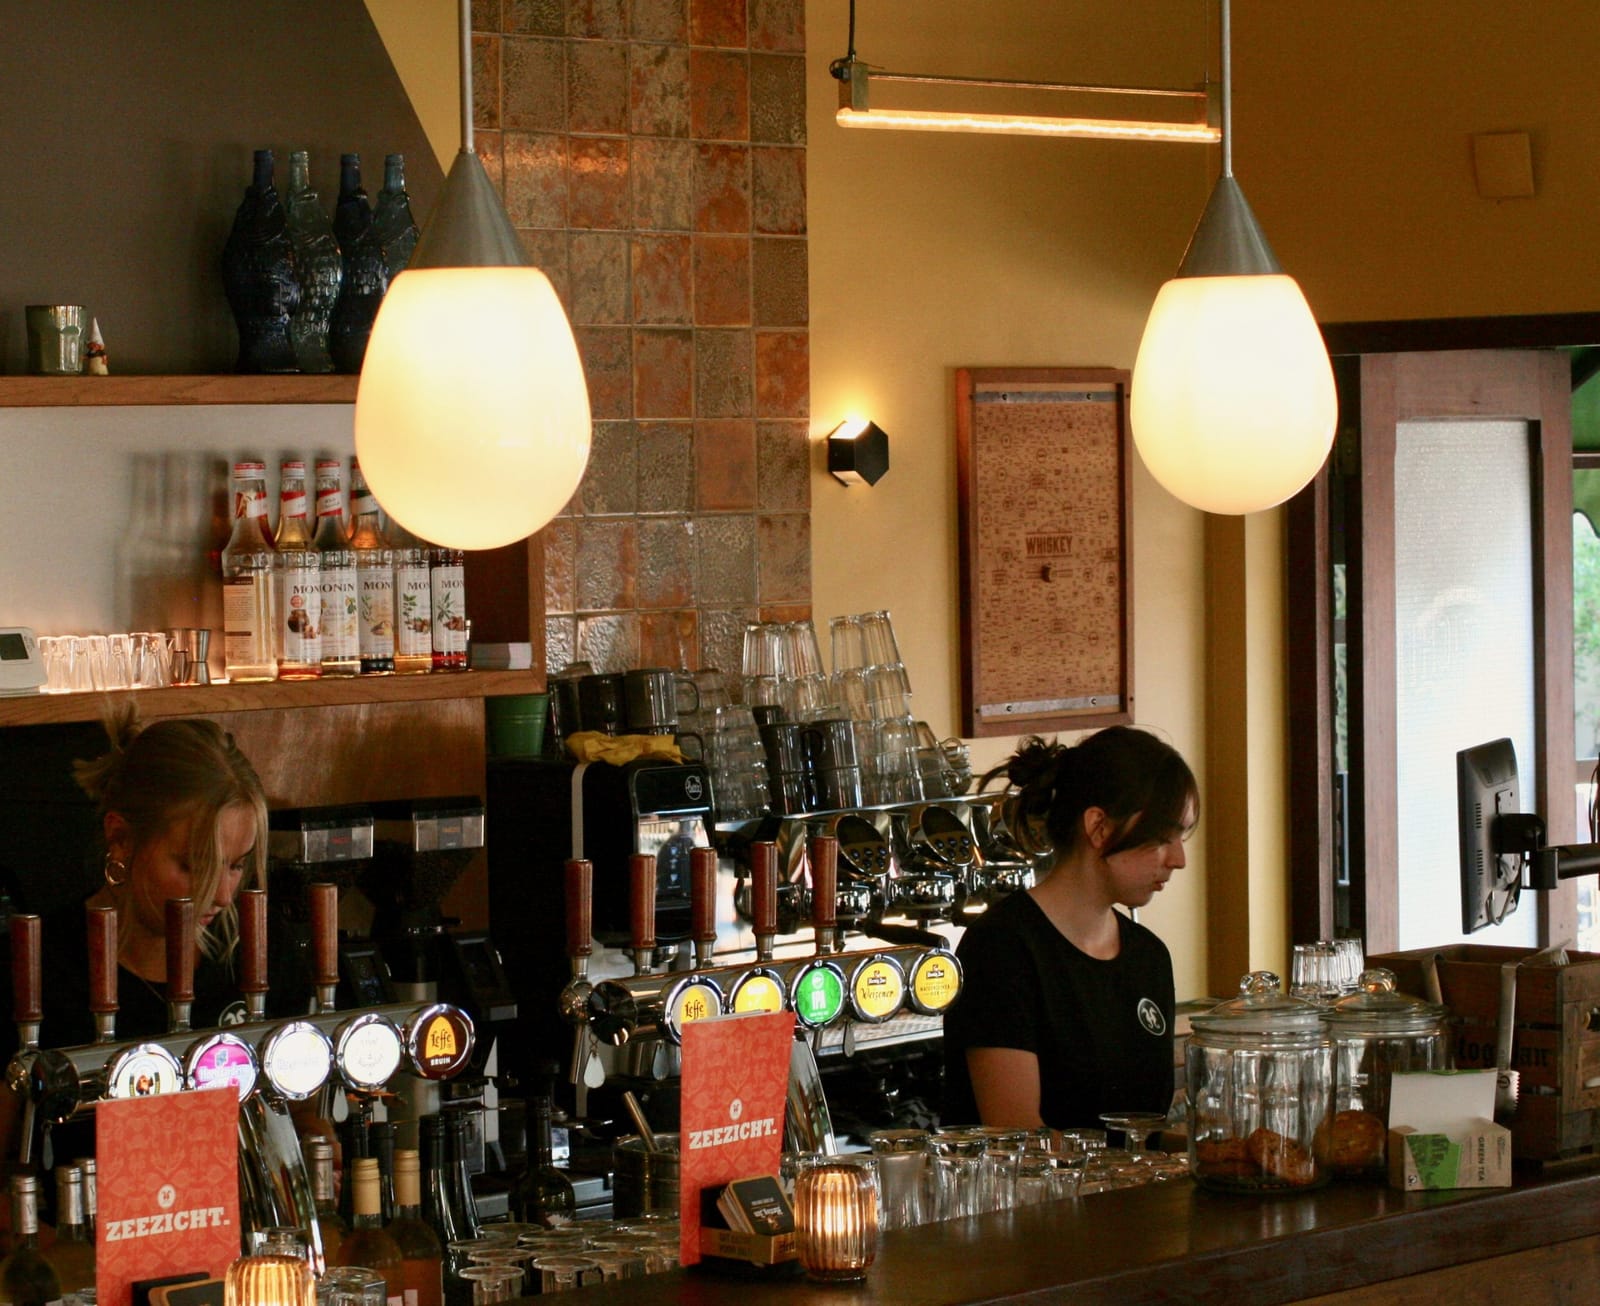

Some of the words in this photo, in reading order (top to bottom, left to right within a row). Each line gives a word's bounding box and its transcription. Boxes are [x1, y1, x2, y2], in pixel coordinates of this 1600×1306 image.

[1025, 536, 1072, 555] WHISKEY
[689, 1118, 778, 1149] ZEEZICHT.
[1477, 1136, 1486, 1165] GREEN
[1478, 1167, 1487, 1182] TEA
[105, 1206, 231, 1242] ZEEZICHT.
